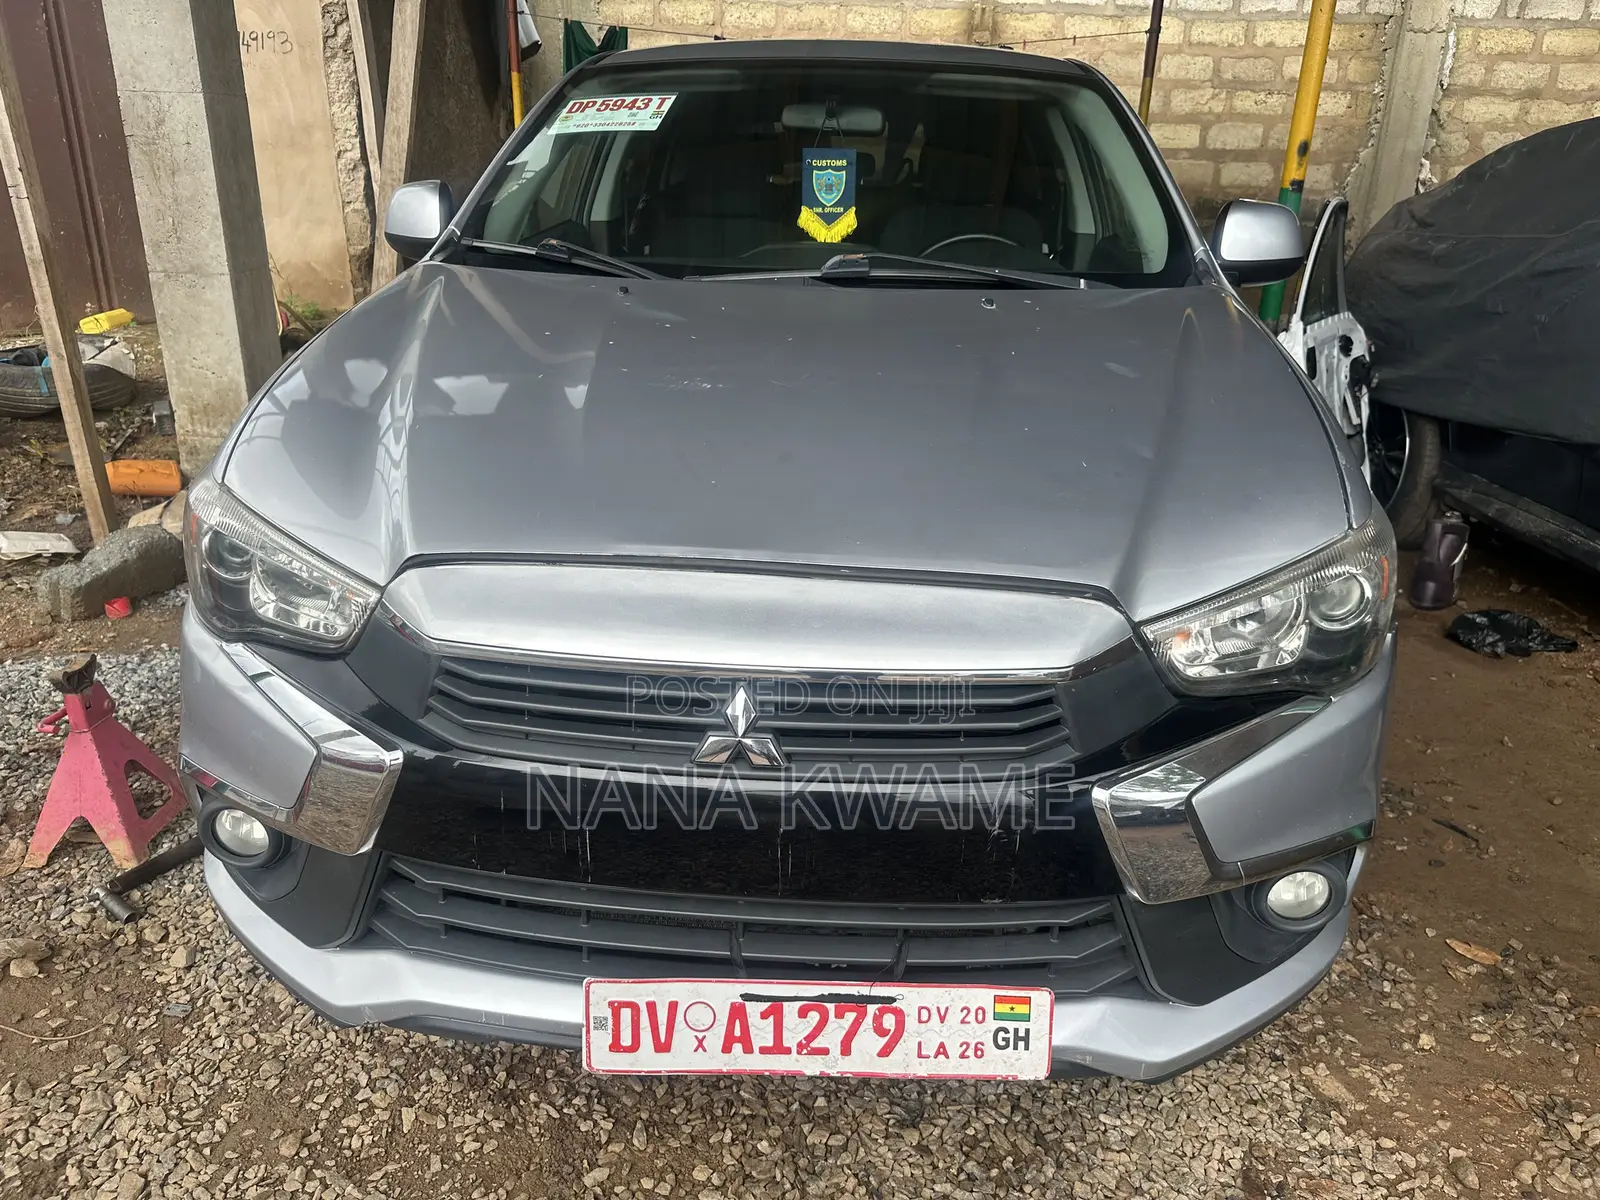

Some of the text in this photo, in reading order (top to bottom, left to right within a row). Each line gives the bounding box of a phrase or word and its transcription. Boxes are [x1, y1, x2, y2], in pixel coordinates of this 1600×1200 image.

[596, 97, 653, 112] 5943
[812, 159, 847, 167] CUSTOMS
[917, 1006, 986, 1024] DV 20
[608, 1000, 679, 1053] DV
[993, 1027, 1031, 1051] GH
[917, 1041, 985, 1059] LA 26
